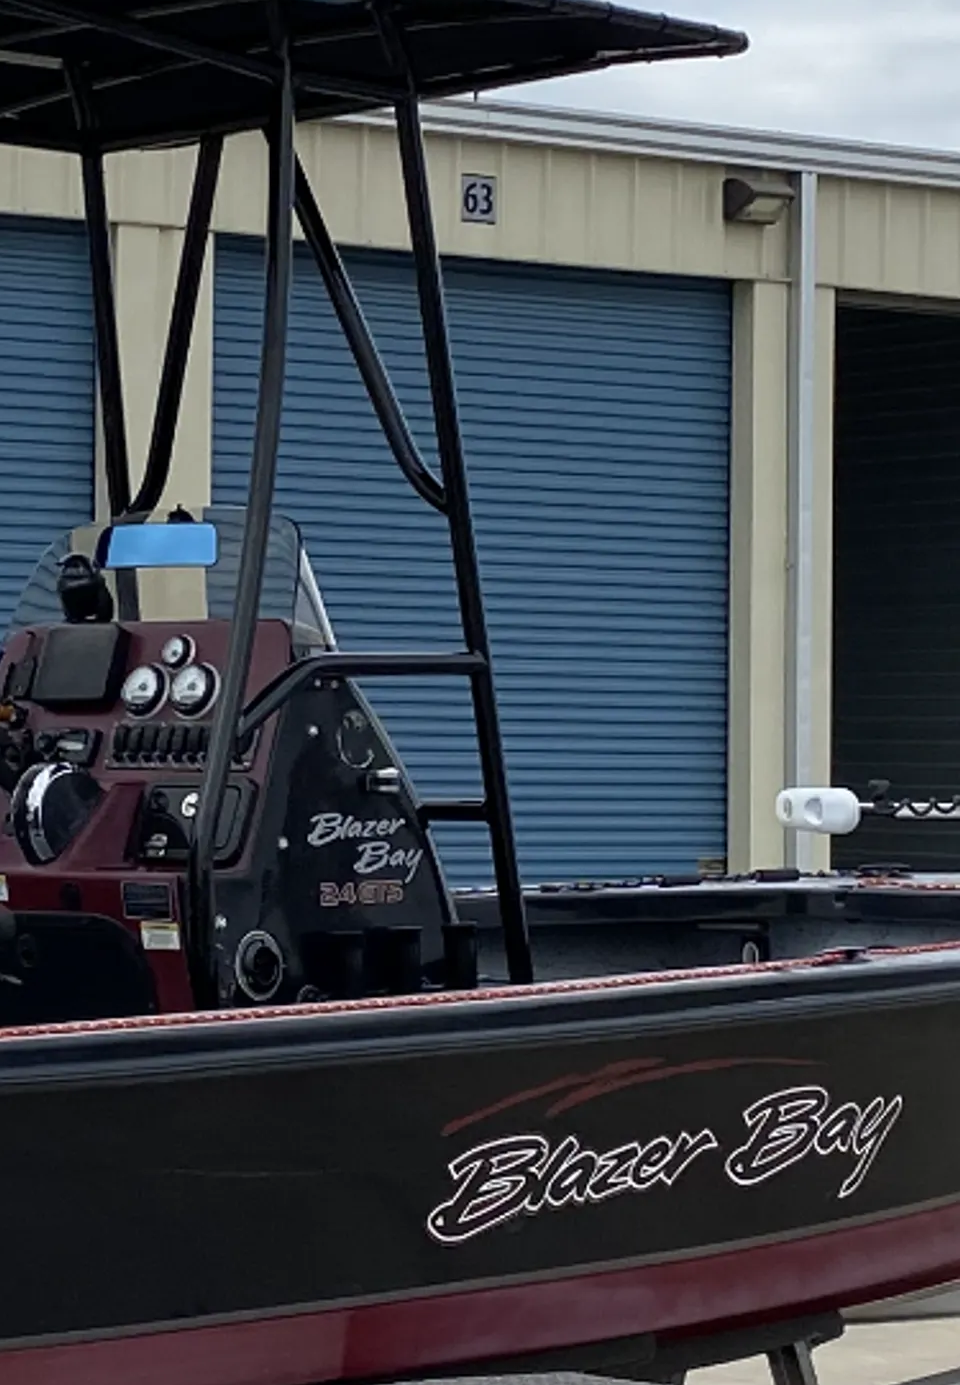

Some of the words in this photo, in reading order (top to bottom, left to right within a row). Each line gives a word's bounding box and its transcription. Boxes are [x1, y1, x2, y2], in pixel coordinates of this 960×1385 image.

[464, 182, 493, 214] 63
[306, 812, 406, 846] Blazer
[353, 840, 424, 884] Bay
[426, 1128, 719, 1243] Blazer
[725, 1085, 904, 1199] Bay
